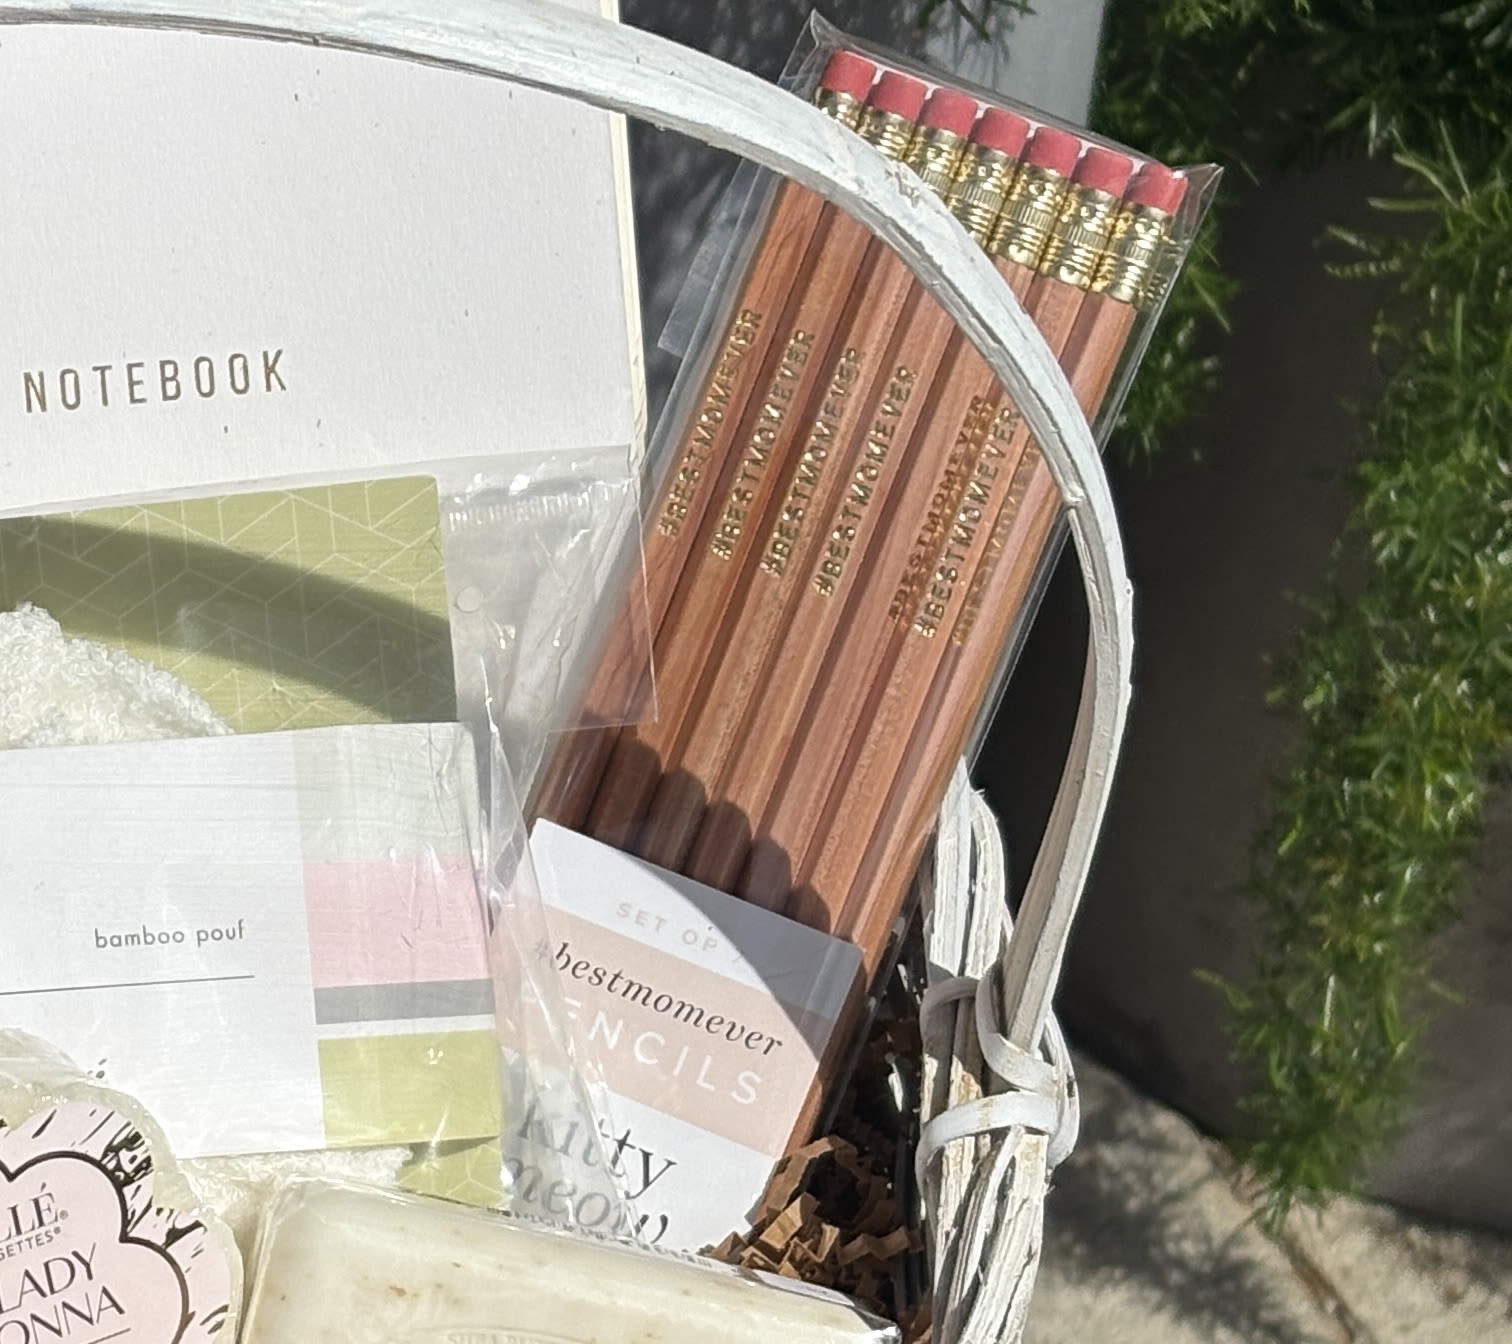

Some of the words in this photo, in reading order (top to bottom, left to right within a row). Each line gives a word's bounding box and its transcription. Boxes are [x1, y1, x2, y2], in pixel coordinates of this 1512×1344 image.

[23, 348, 287, 413] NOTEBOOK
[615, 902, 668, 933] SET
[94, 924, 186, 949] bamboo
[195, 918, 245, 948] pouf
